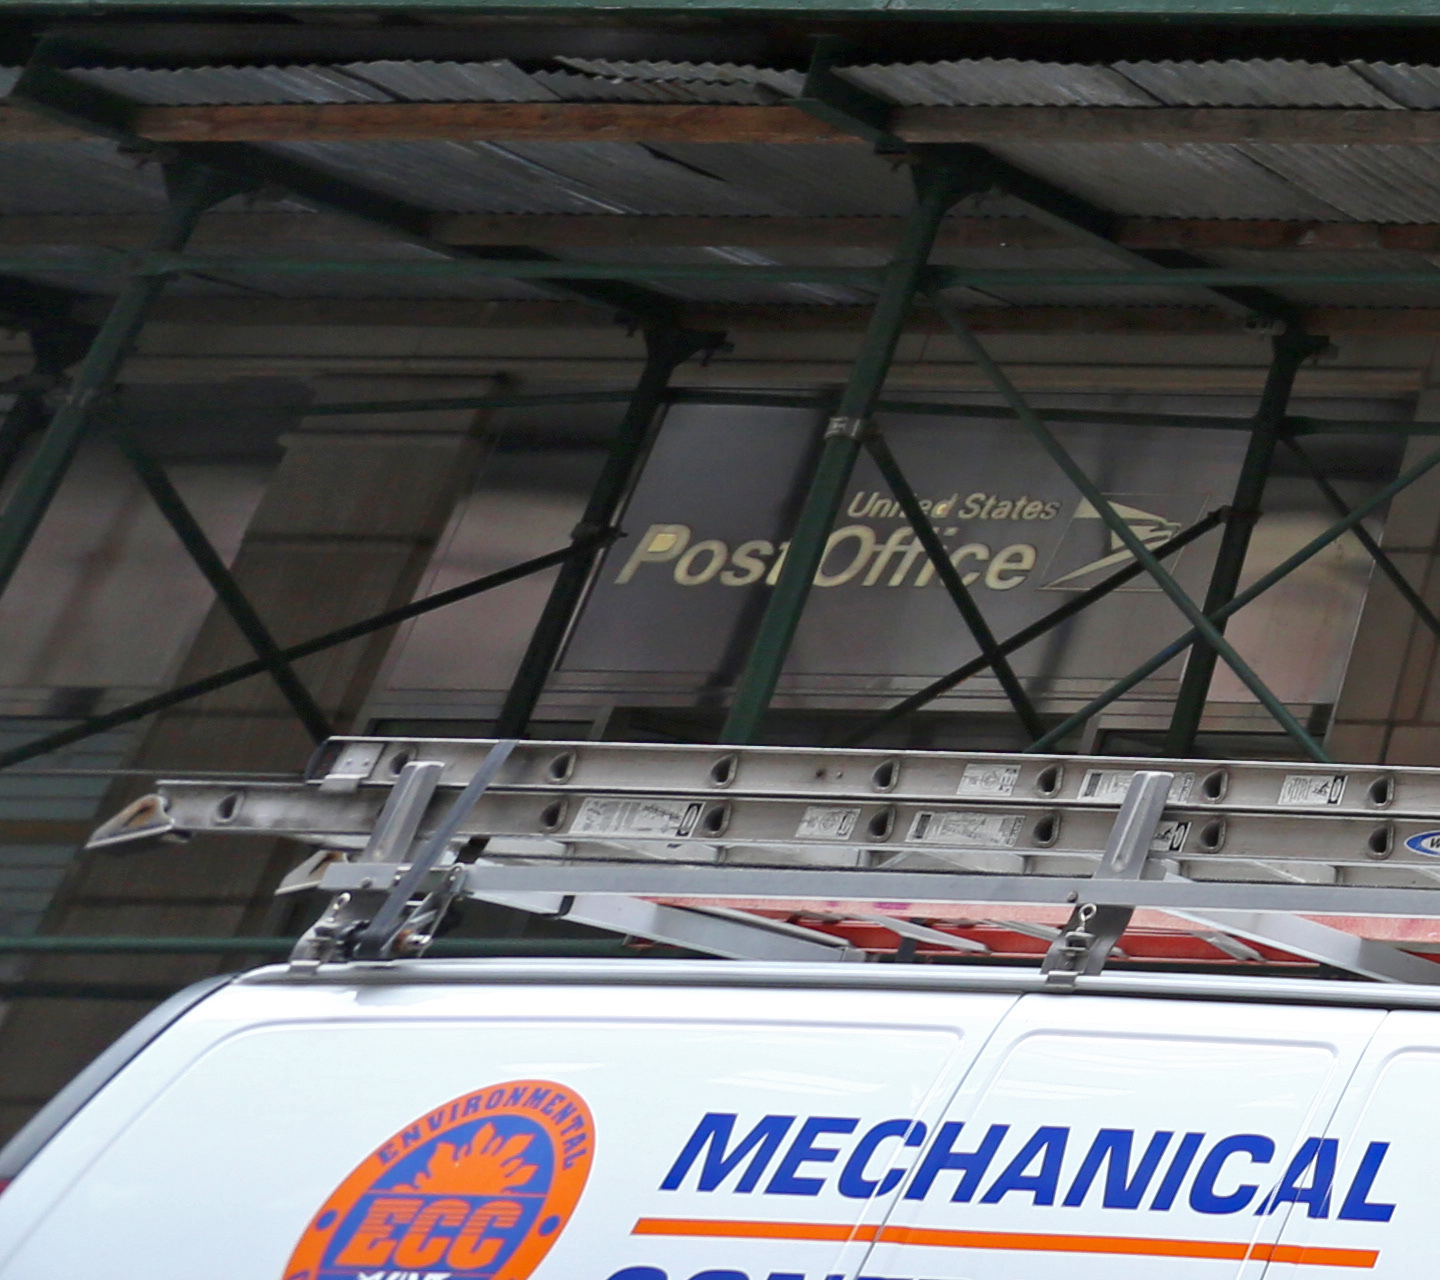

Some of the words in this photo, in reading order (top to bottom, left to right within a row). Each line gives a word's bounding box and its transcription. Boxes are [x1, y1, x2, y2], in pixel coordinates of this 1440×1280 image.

[846, 491, 956, 520] Unied
[957, 491, 1062, 521] States
[376, 1086, 588, 1171] ENVIRONMENTAL
[659, 1111, 1398, 1223] MECHANICAL
[332, 1197, 524, 1270] ECC
